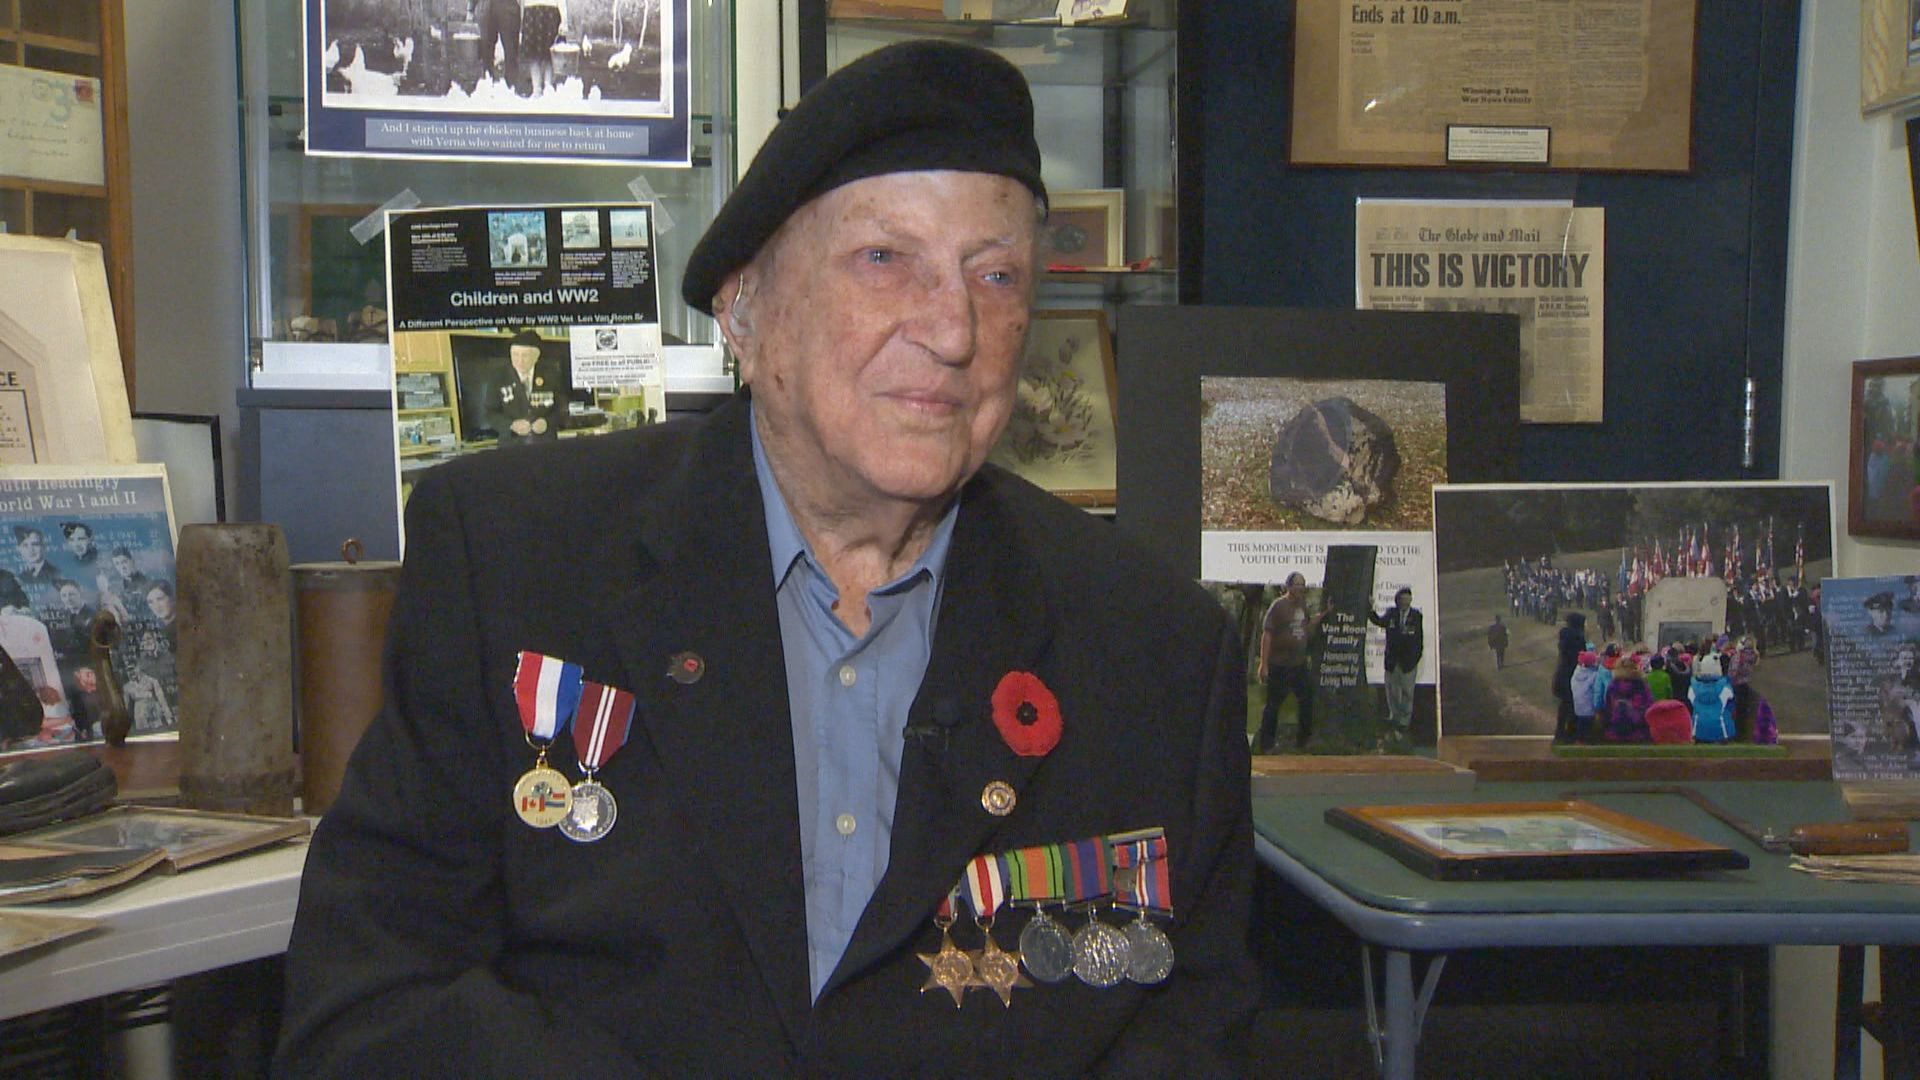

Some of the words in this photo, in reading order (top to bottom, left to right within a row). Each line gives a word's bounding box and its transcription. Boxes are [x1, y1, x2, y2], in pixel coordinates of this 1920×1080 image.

[1352, 4, 1384, 24] Ends
[1391, 6, 1405, 24] at
[1413, 5, 1429, 24] 10
[1433, 10, 1461, 24] a.m.
[382, 122, 402, 133] And
[405, 123, 409, 133] I
[412, 123, 447, 134] started
[450, 126, 462, 137] up
[465, 125, 480, 135] the
[484, 125, 522, 136] chicken
[524, 126, 567, 137] business
[569, 127, 592, 137] back
[595, 129, 604, 138] at
[606, 128, 634, 138] home
[411, 136, 433, 146] with
[436, 137, 465, 147] Verna
[468, 137, 490, 147] who
[492, 139, 525, 149] waited
[527, 139, 542, 149] for
[544, 141, 559, 149] me
[562, 141, 572, 150] to
[574, 142, 606, 151] return
[1419, 227, 1441, 242] The
[1445, 228, 1479, 242] Globe
[1482, 228, 1504, 242] and
[1508, 228, 1540, 242] Mail
[1370, 253, 1430, 287] THIS
[1438, 253, 1463, 287] IS
[1471, 253, 1590, 288] VICTORY
[450, 291, 519, 306] Children
[523, 290, 553, 304] and
[557, 289, 600, 303] WW2
[407, 319, 443, 328] Different
[445, 318, 493, 327] Perspective
[507, 316, 525, 325] War
[526, 315, 536, 325] by
[537, 315, 558, 324] WW2
[577, 314, 593, 322] Len
[0, 497, 33, 513] orld
[40, 495, 73, 510] War
[79, 494, 86, 509] I
[91, 492, 121, 507] and
[124, 491, 138, 505] II
[1228, 544, 1250, 553] THIS
[1252, 544, 1312, 554] MONUMENT
[1315, 544, 1325, 553] IS
[1386, 545, 1399, 554] TO
[1401, 545, 1421, 555] THE
[1240, 555, 1275, 564] YOUTH
[1278, 555, 1289, 564] OF
[1295, 555, 1313, 564] THE
[1336, 613, 1355, 623] The
[1321, 623, 1340, 633] Van
[1343, 624, 1367, 634] Roon
[1327, 635, 1360, 648] Family
